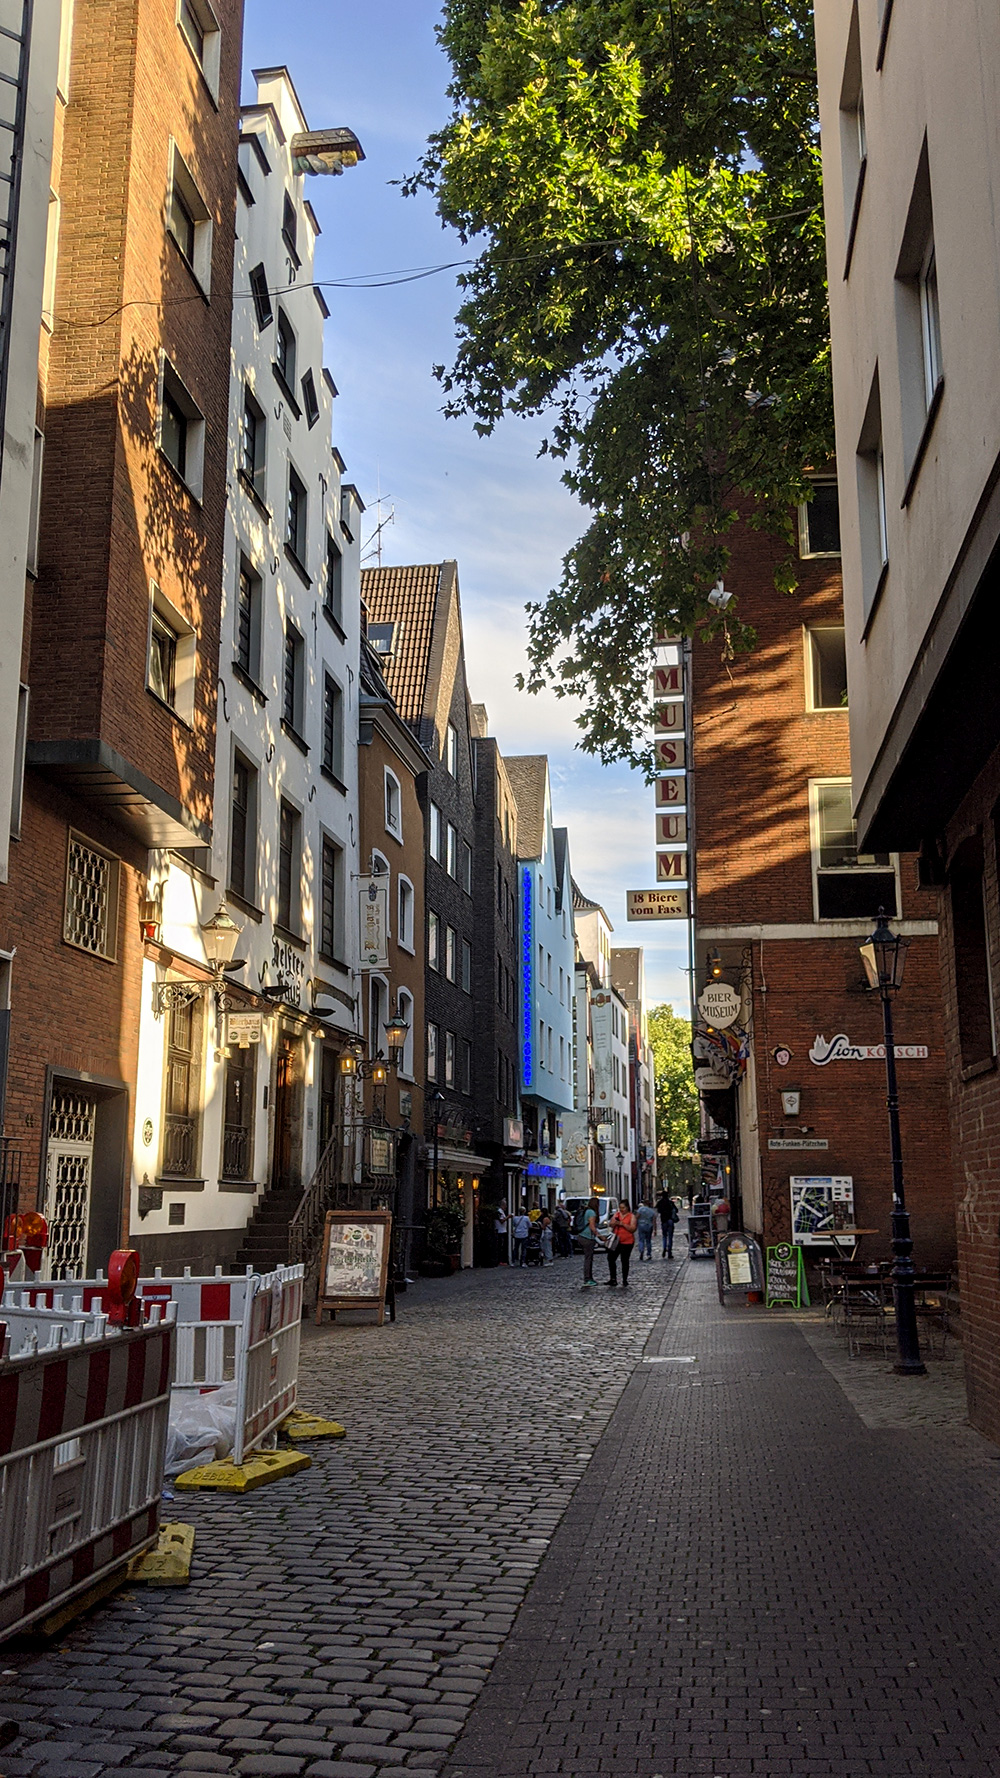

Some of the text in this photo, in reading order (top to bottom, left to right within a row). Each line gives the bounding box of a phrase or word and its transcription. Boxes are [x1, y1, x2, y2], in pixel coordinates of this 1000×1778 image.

[655, 667, 683, 877] MUSEUM
[633, 893, 678, 903] 18 Biere
[630, 905, 682, 915] vom Fass
[707, 993, 732, 1003] BIER
[702, 1003, 738, 1019] MUSEUM
[812, 1036, 926, 1063] Sion KÖSCH
